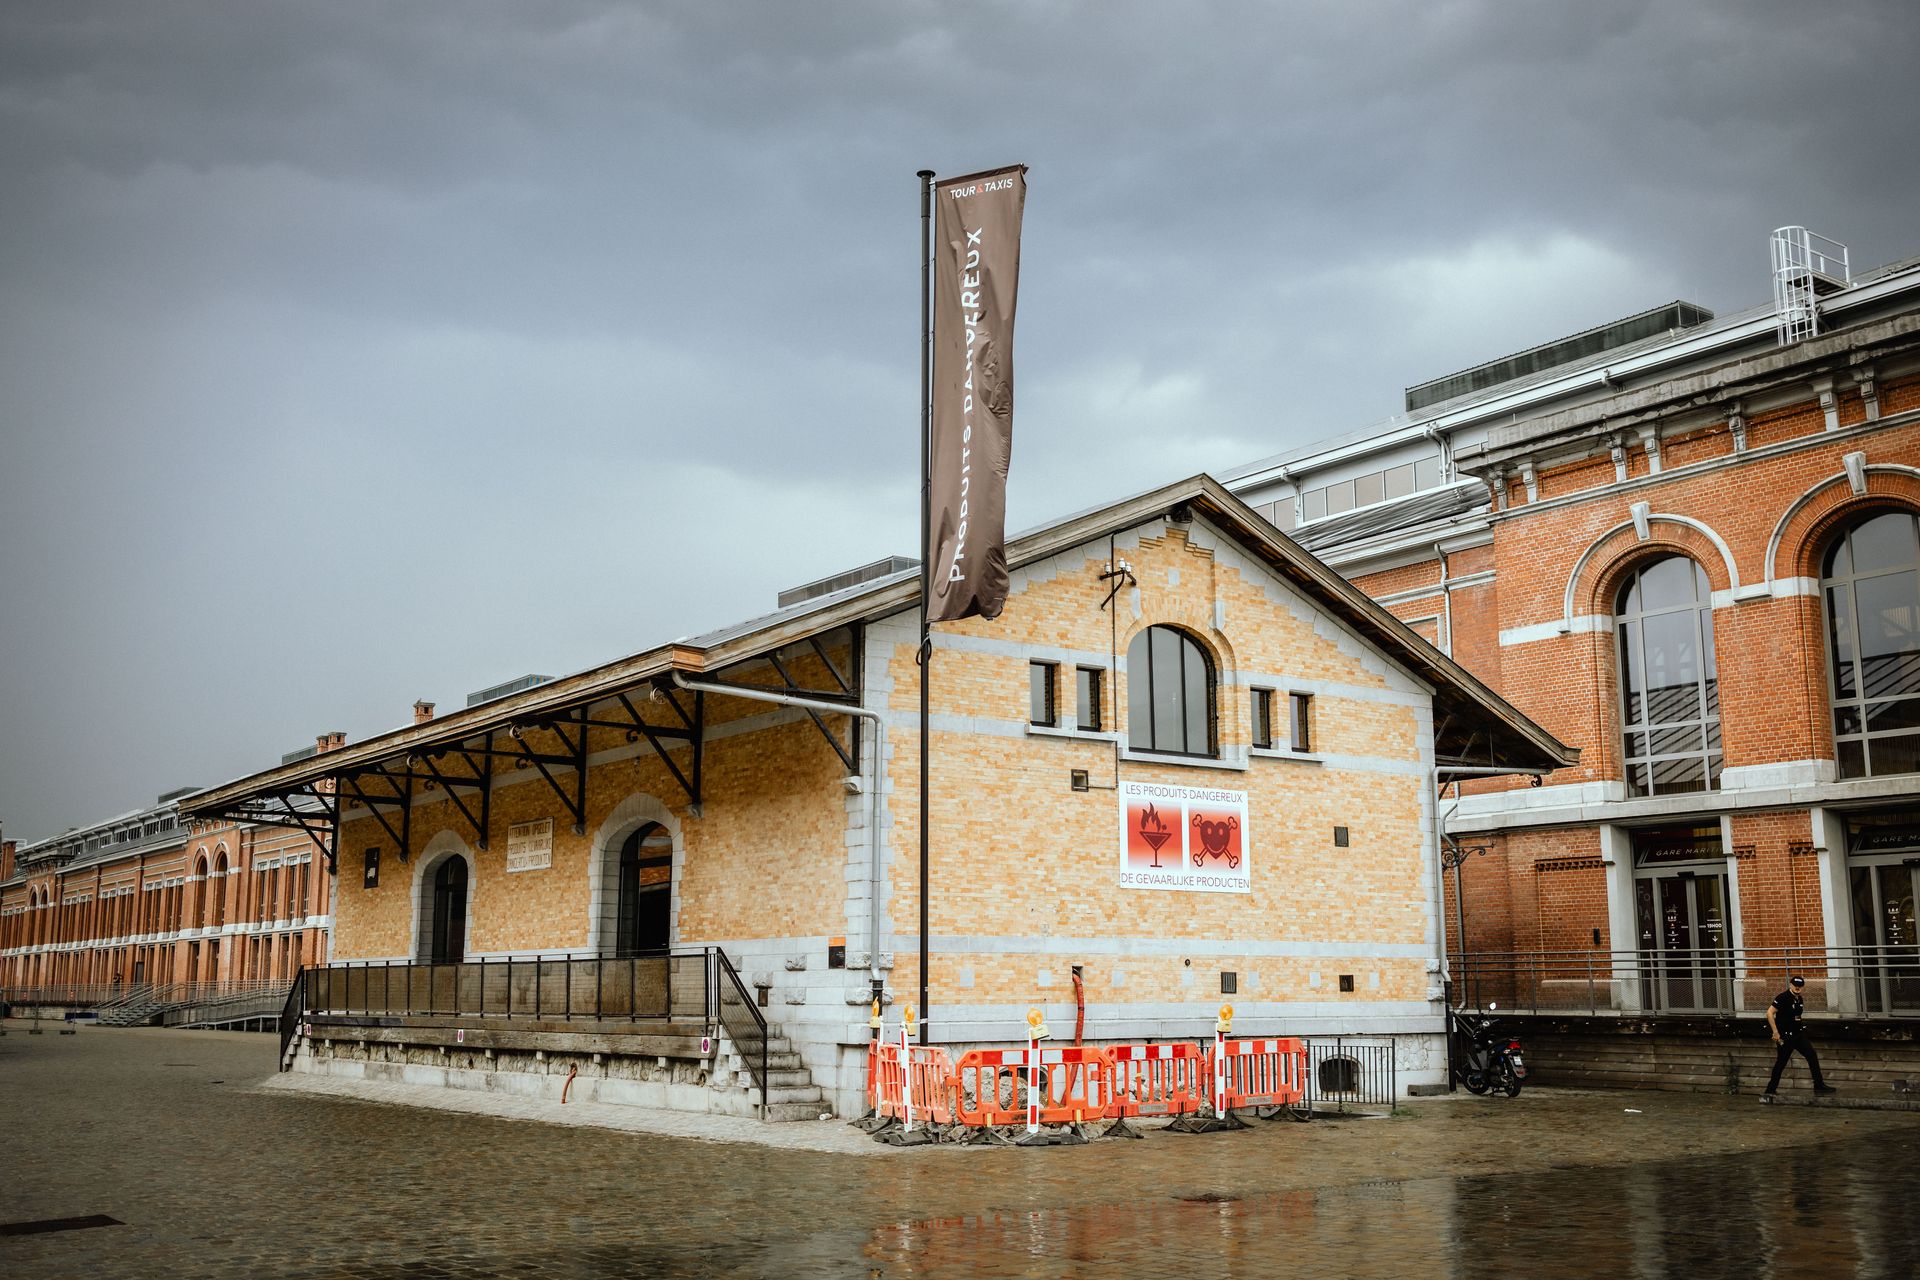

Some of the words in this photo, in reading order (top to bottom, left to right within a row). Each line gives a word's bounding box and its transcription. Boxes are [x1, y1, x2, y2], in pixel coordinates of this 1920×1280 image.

[1125, 784, 1141, 795] LES
[1143, 786, 1188, 799] PRODUITS
[1189, 789, 1243, 803] DANGEREUX
[1656, 848, 1681, 856] GARE
[1120, 872, 1133, 884] DE
[1135, 873, 1195, 887] GEVAARLIJKE
[1196, 876, 1250, 889] PRODUCTEN
